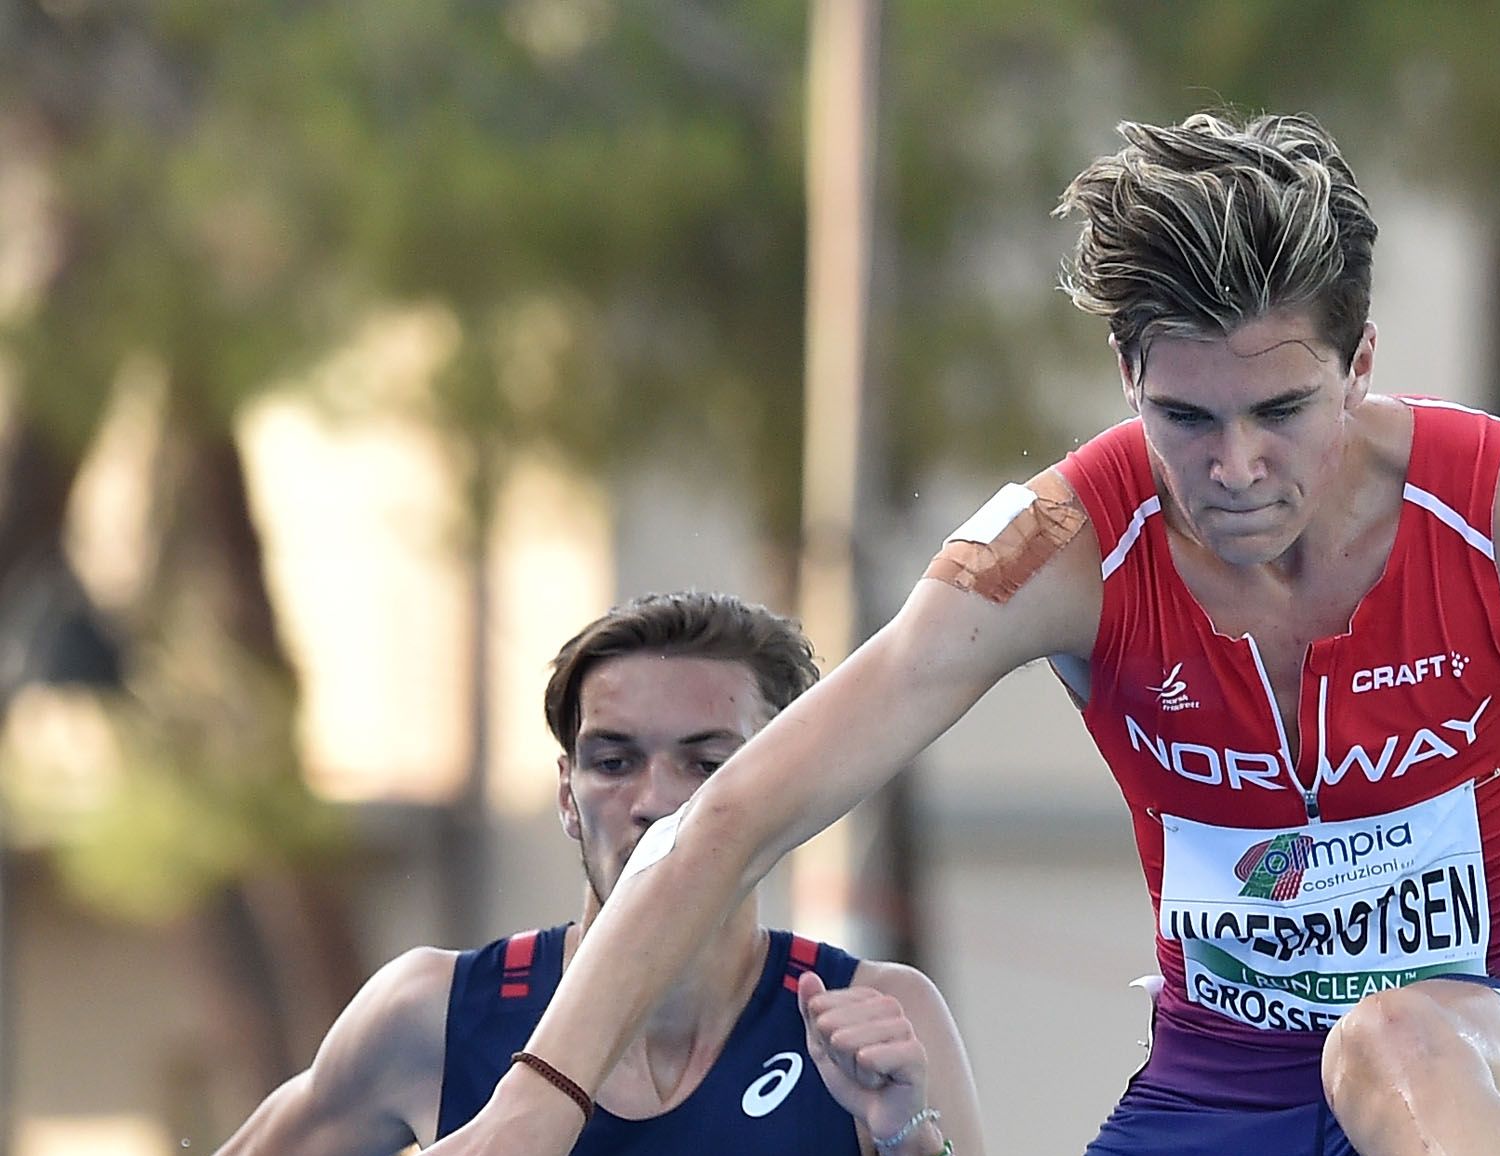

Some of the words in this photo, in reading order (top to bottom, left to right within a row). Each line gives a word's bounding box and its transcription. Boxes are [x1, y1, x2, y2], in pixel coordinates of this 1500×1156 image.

[1351, 653, 1446, 693] CRAFT
[1124, 695, 1493, 791] NORWAY
[1264, 822, 1413, 875] olimpia
[1302, 858, 1398, 893] costruzioni
[1242, 967, 1249, 984] I
[1256, 973, 1312, 996] RUN
